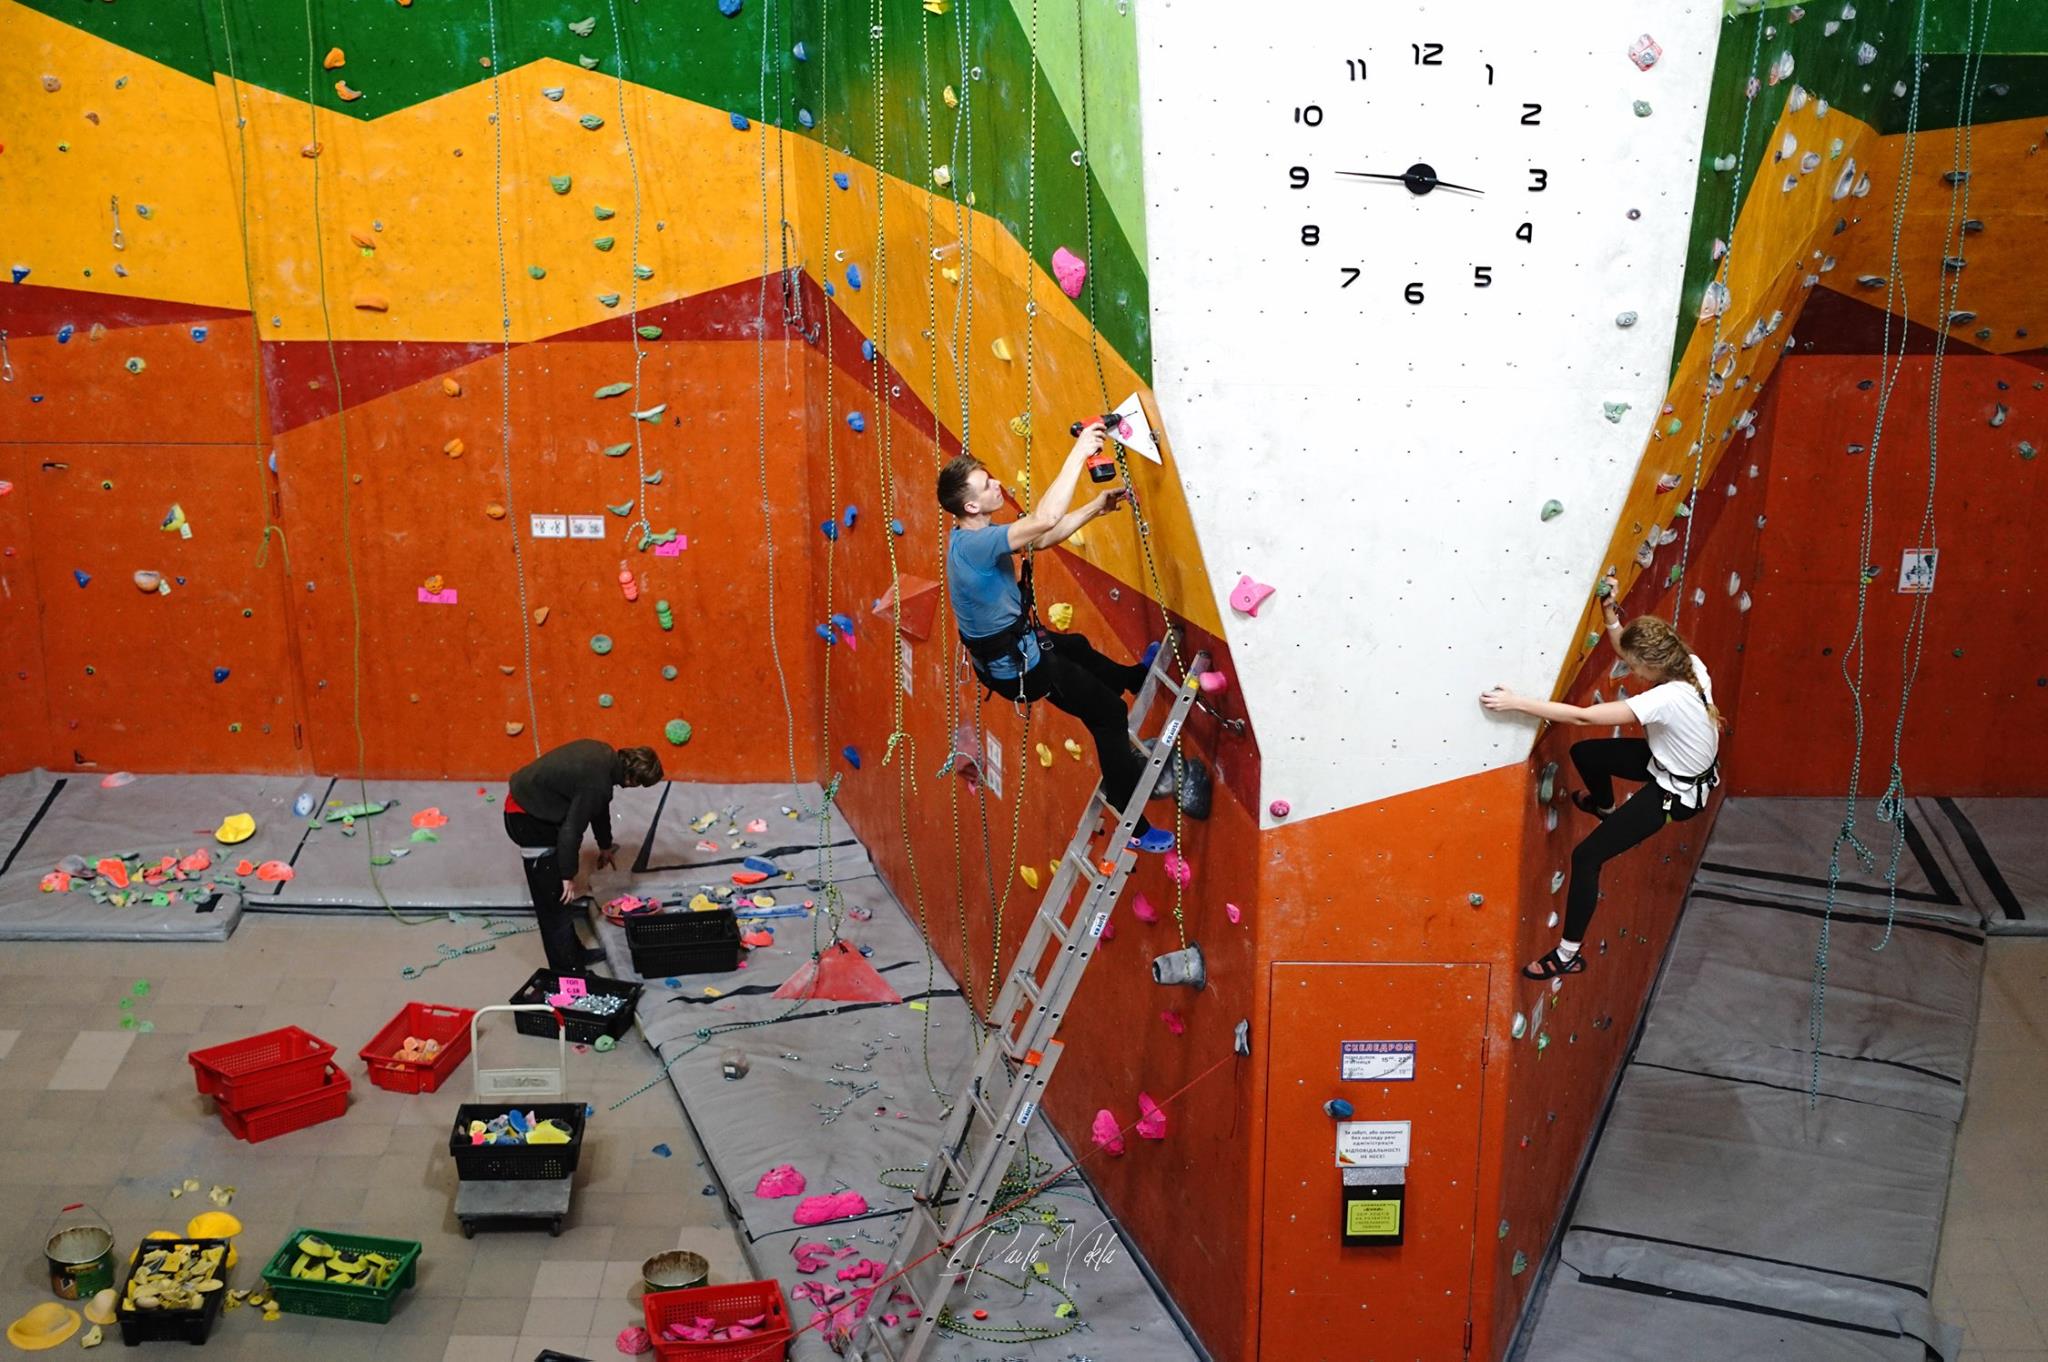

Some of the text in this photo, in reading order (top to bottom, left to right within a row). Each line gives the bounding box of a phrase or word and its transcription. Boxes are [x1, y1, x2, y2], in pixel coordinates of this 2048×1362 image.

[1412, 43, 1444, 65] 12
[1346, 59, 1366, 81] 11
[1485, 63, 1494, 85] 1
[1294, 105, 1323, 127] 10
[1520, 103, 1542, 126] 2
[1289, 166, 1310, 189] 9
[1528, 168, 1548, 192] 3
[1301, 224, 1320, 246] 8
[1515, 222, 1533, 243] 4
[1340, 267, 1361, 288] 7
[1473, 266, 1492, 287] 5
[1404, 282, 1425, 305] 6
